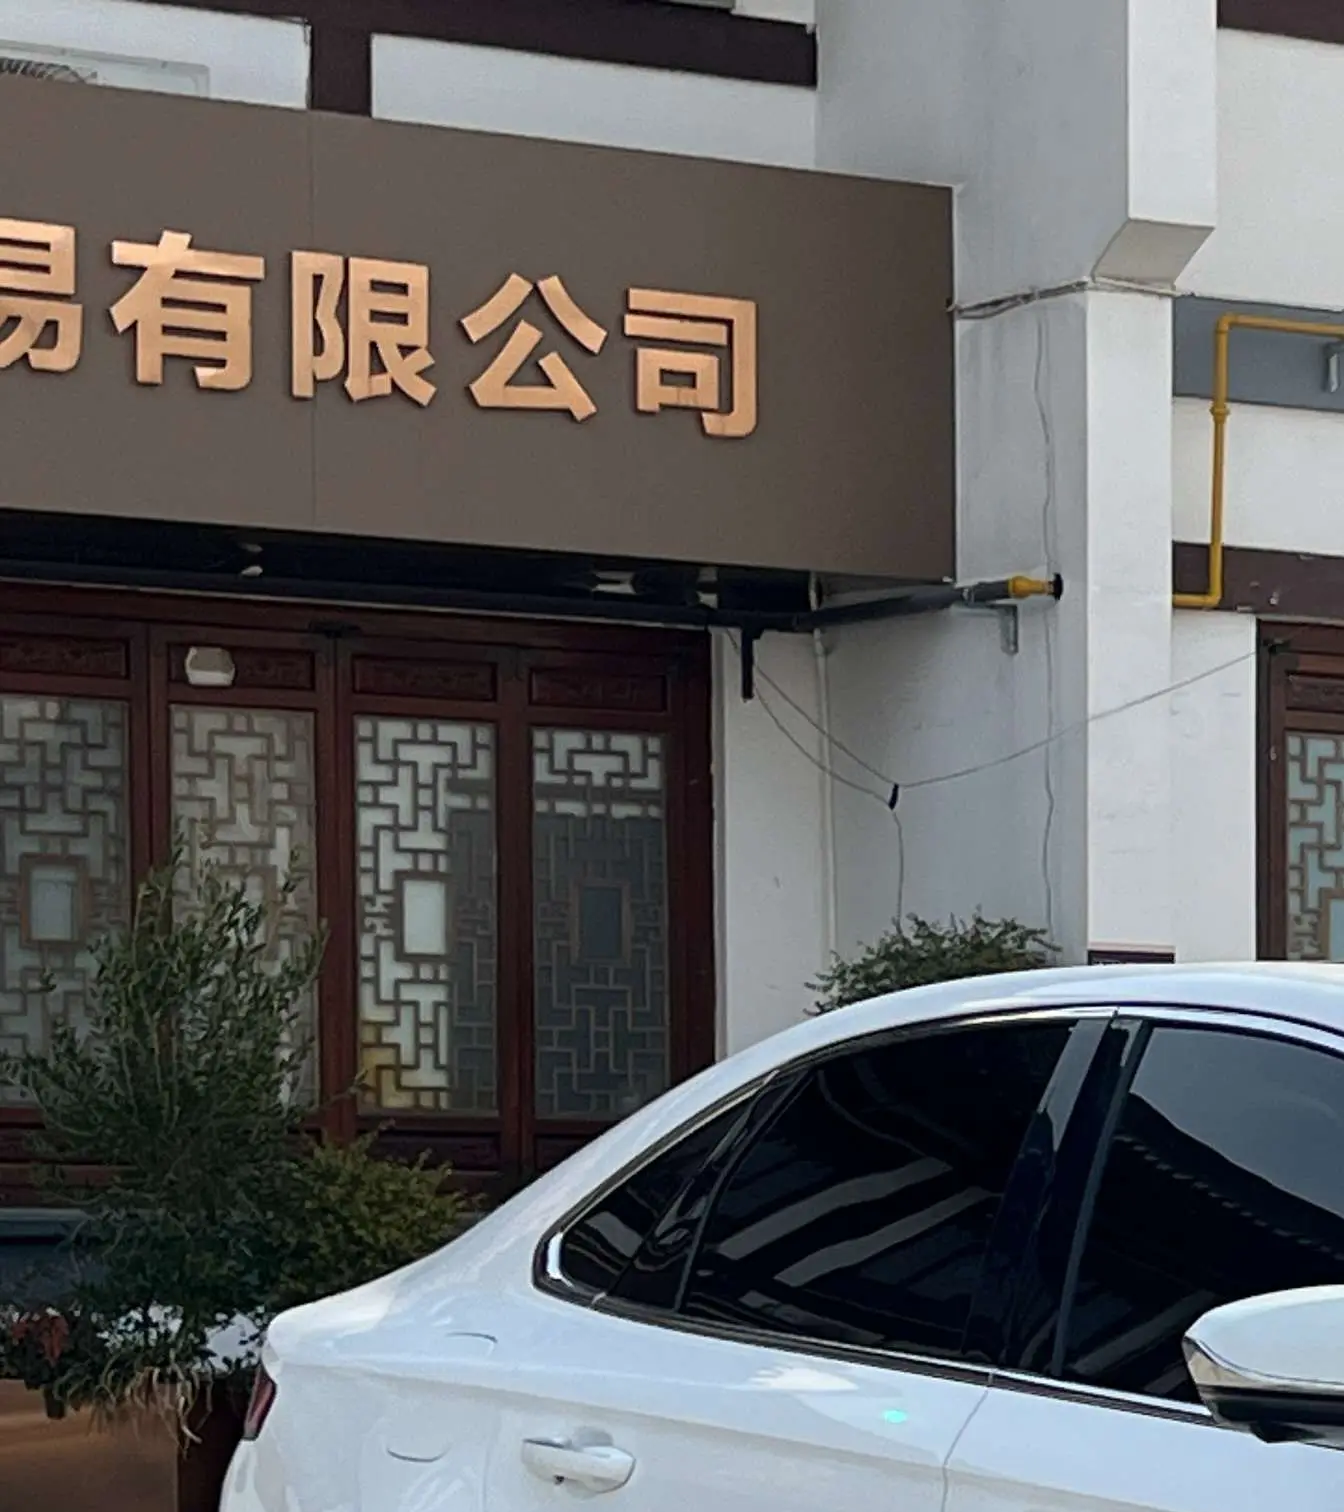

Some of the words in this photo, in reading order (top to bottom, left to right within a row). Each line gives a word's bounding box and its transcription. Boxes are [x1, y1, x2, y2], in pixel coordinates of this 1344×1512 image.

[0, 217, 758, 438] 易有限公司
